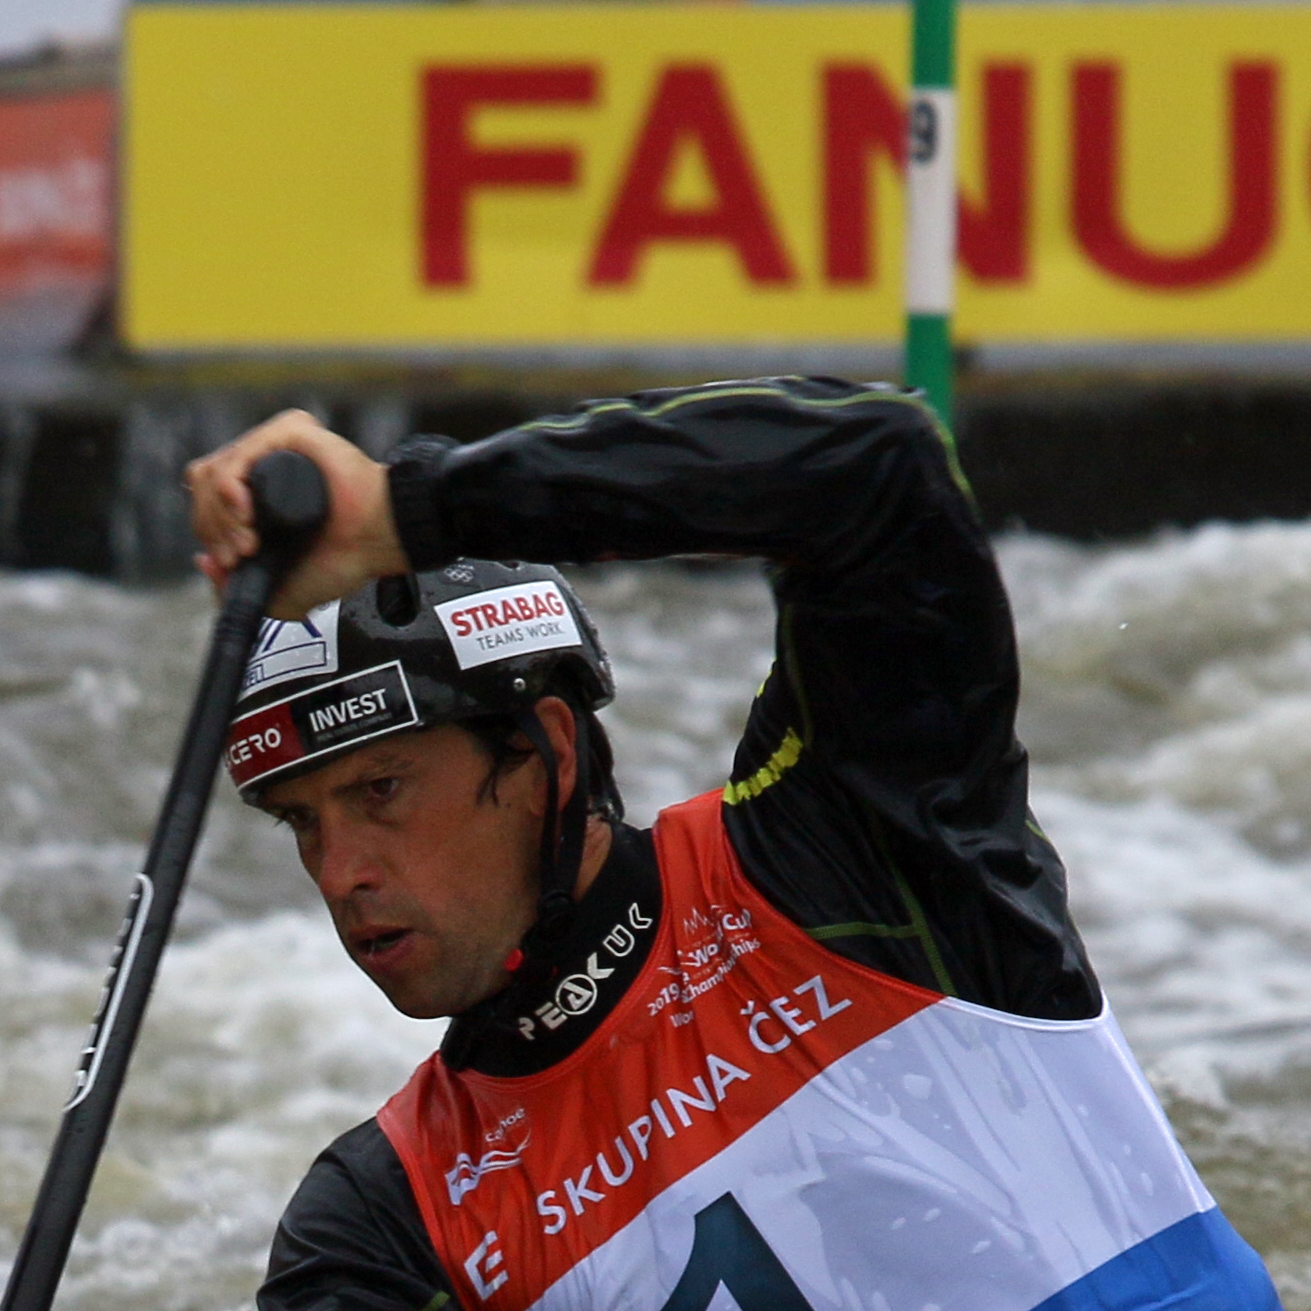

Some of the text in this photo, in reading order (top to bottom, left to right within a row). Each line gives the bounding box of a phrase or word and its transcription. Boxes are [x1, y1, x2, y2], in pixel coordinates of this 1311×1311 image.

[451, 591, 565, 637] STRABAG
[476, 628, 525, 651] TEAMS
[226, 727, 282, 766] CERO
[309, 688, 387, 732] INVEST
[647, 982, 680, 1017] 2019
[537, 974, 853, 1235] SKUPINA ČEZ
